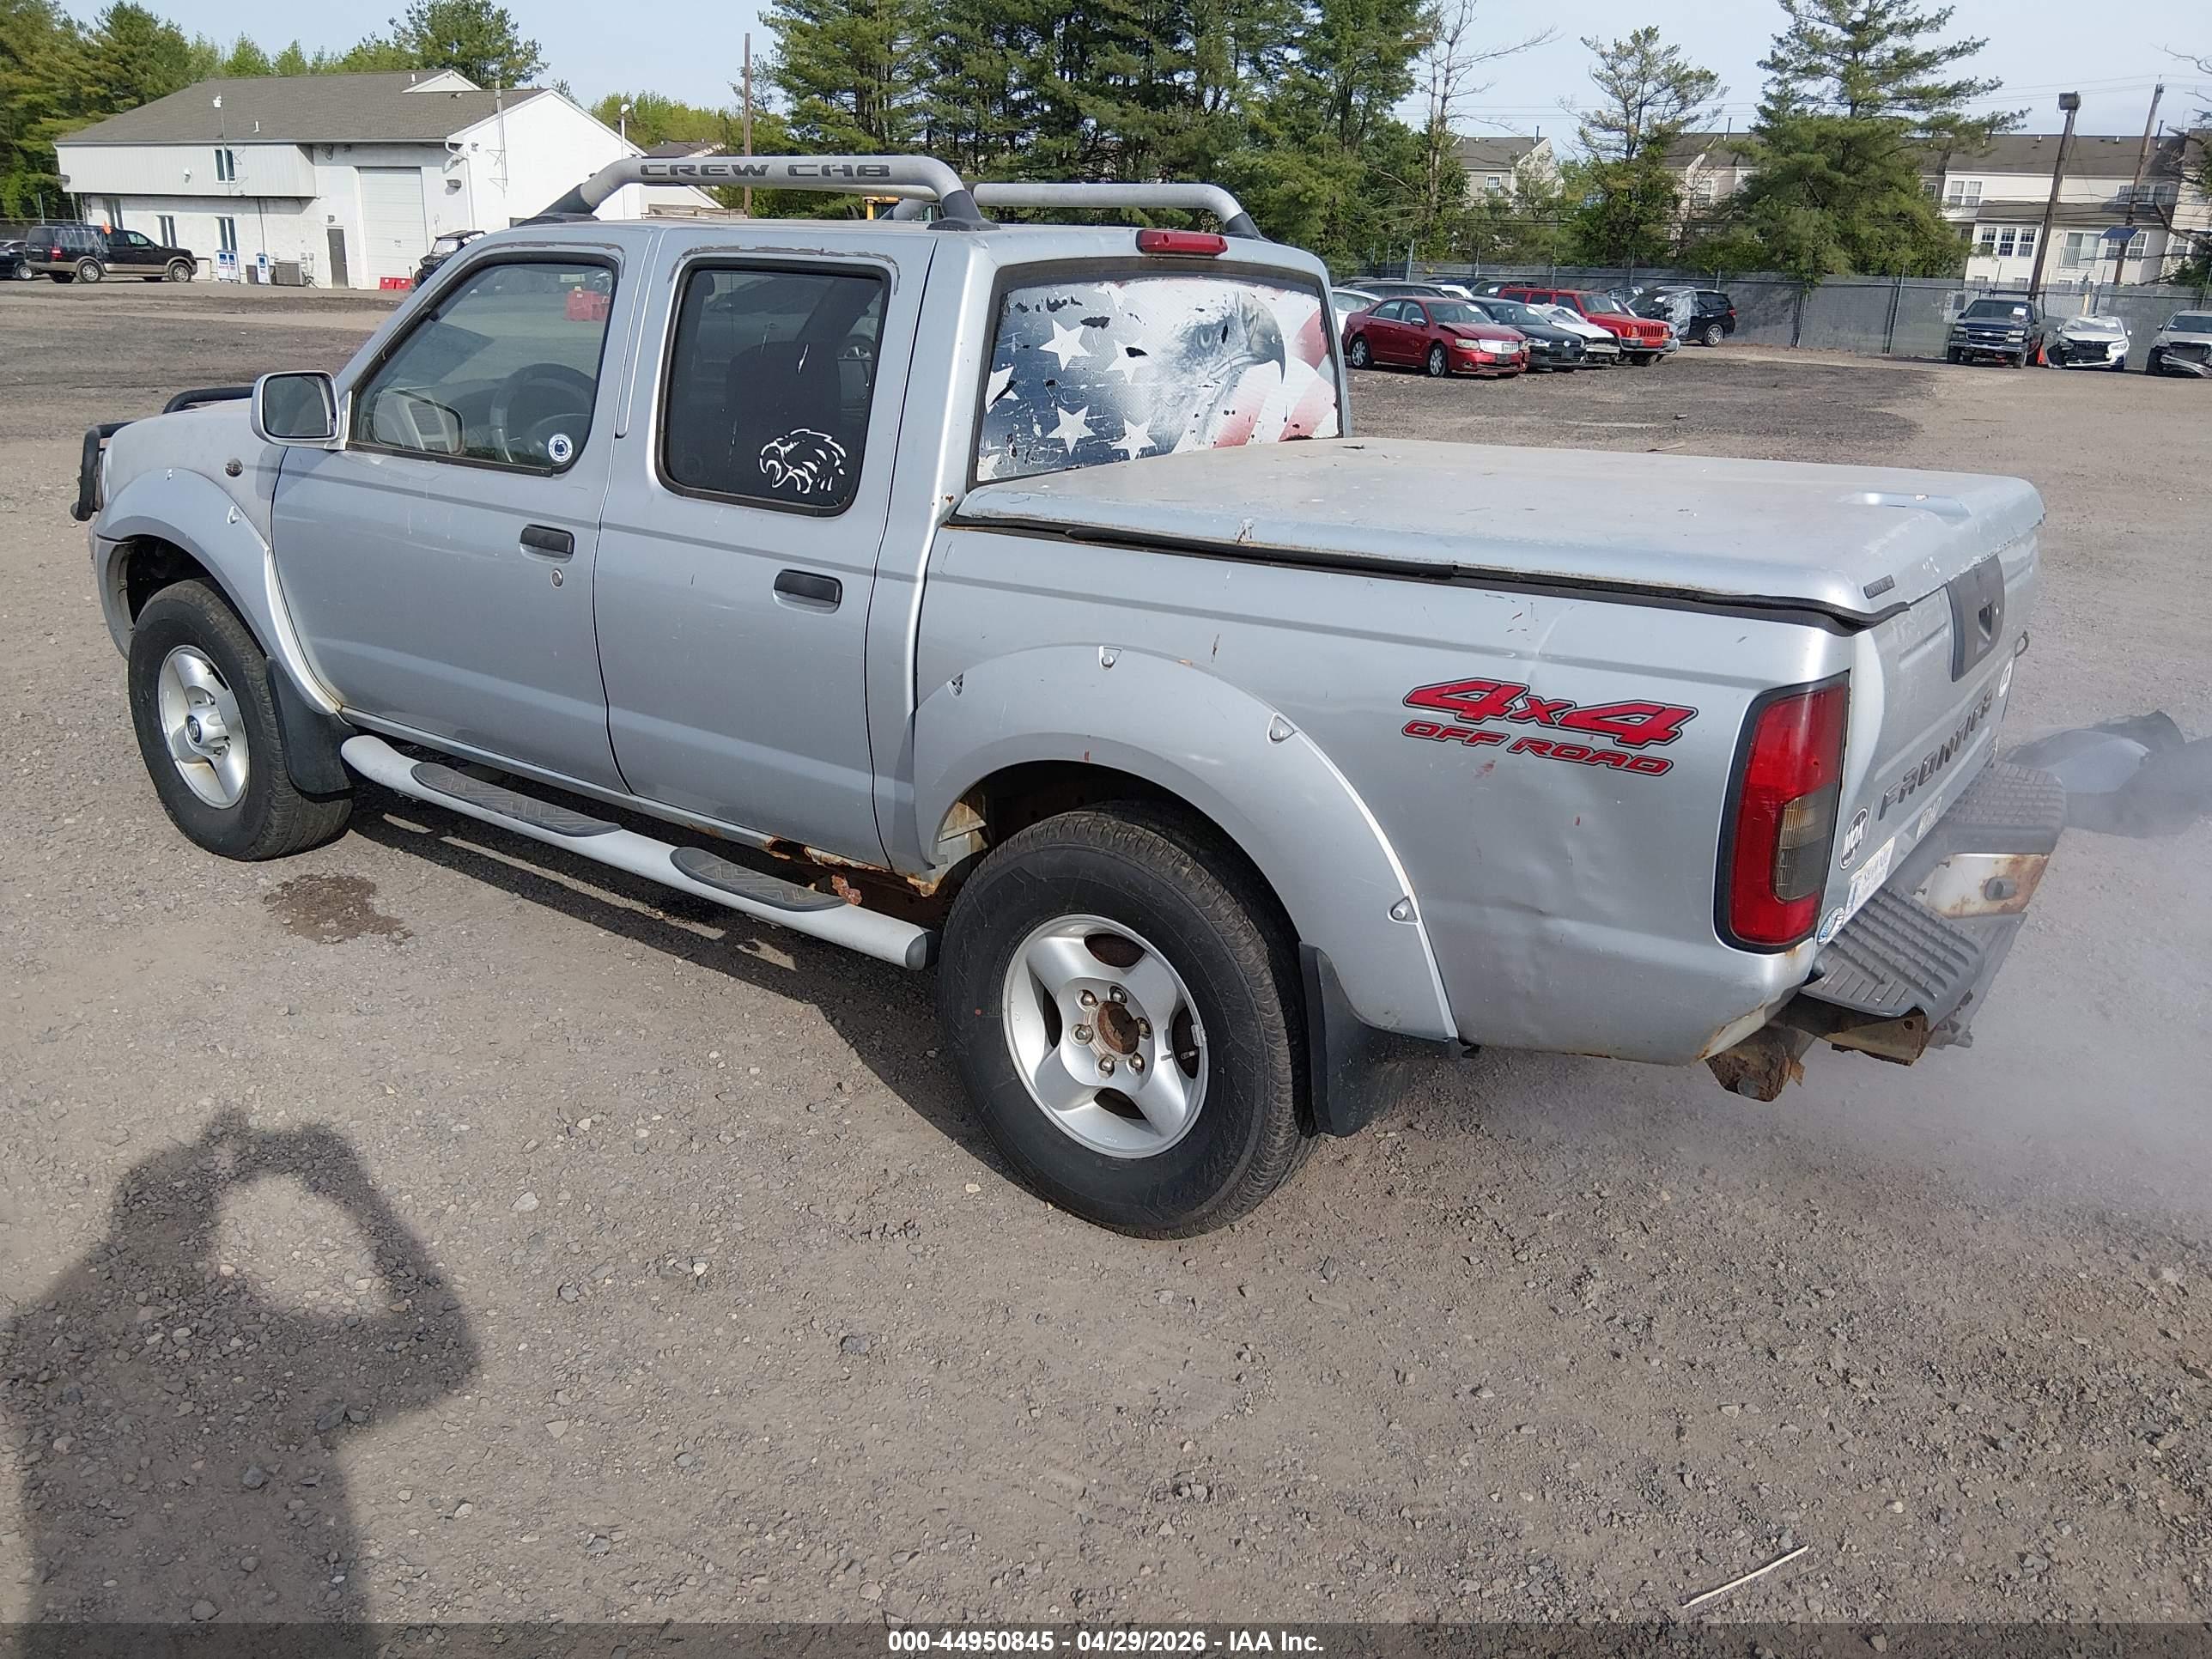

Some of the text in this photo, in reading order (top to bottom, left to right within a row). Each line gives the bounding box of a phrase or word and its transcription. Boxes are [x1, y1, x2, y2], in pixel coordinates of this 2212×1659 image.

[640, 164, 890, 177] CREW CAB
[1402, 677, 1698, 749] 4x4
[1401, 720, 1674, 776] OFF ROAD
[1878, 689, 1993, 822] FRONTIER
